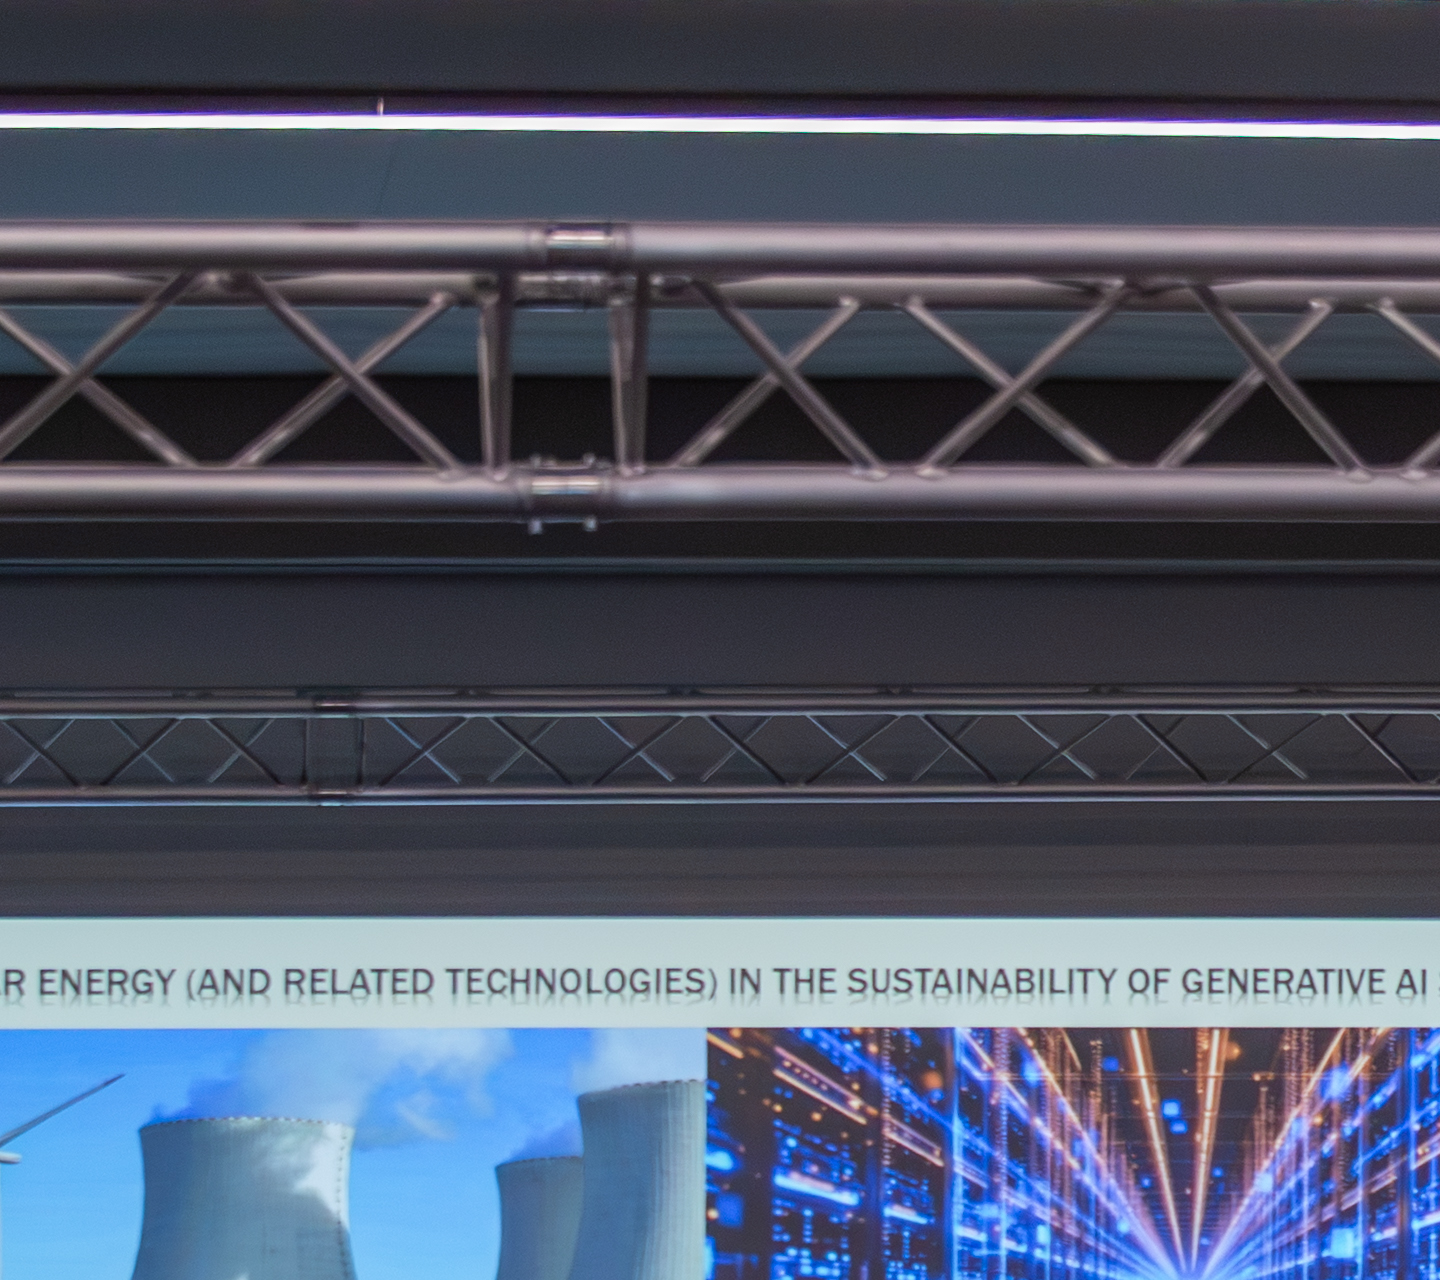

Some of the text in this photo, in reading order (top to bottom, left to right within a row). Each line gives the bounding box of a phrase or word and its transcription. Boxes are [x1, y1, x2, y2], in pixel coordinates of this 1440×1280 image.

[37, 967, 176, 998] ENERGY
[185, 967, 272, 1001] (AND
[282, 967, 436, 997] RELATED
[444, 967, 719, 1000] TECHNOLOGIES)
[728, 967, 762, 997] IN
[771, 967, 837, 996] THE
[846, 966, 1118, 997] SUSTAINABILITY
[1126, 966, 1172, 997] OF
[1180, 966, 1387, 998] GENERATIVE
[1394, 967, 1429, 997] AI
